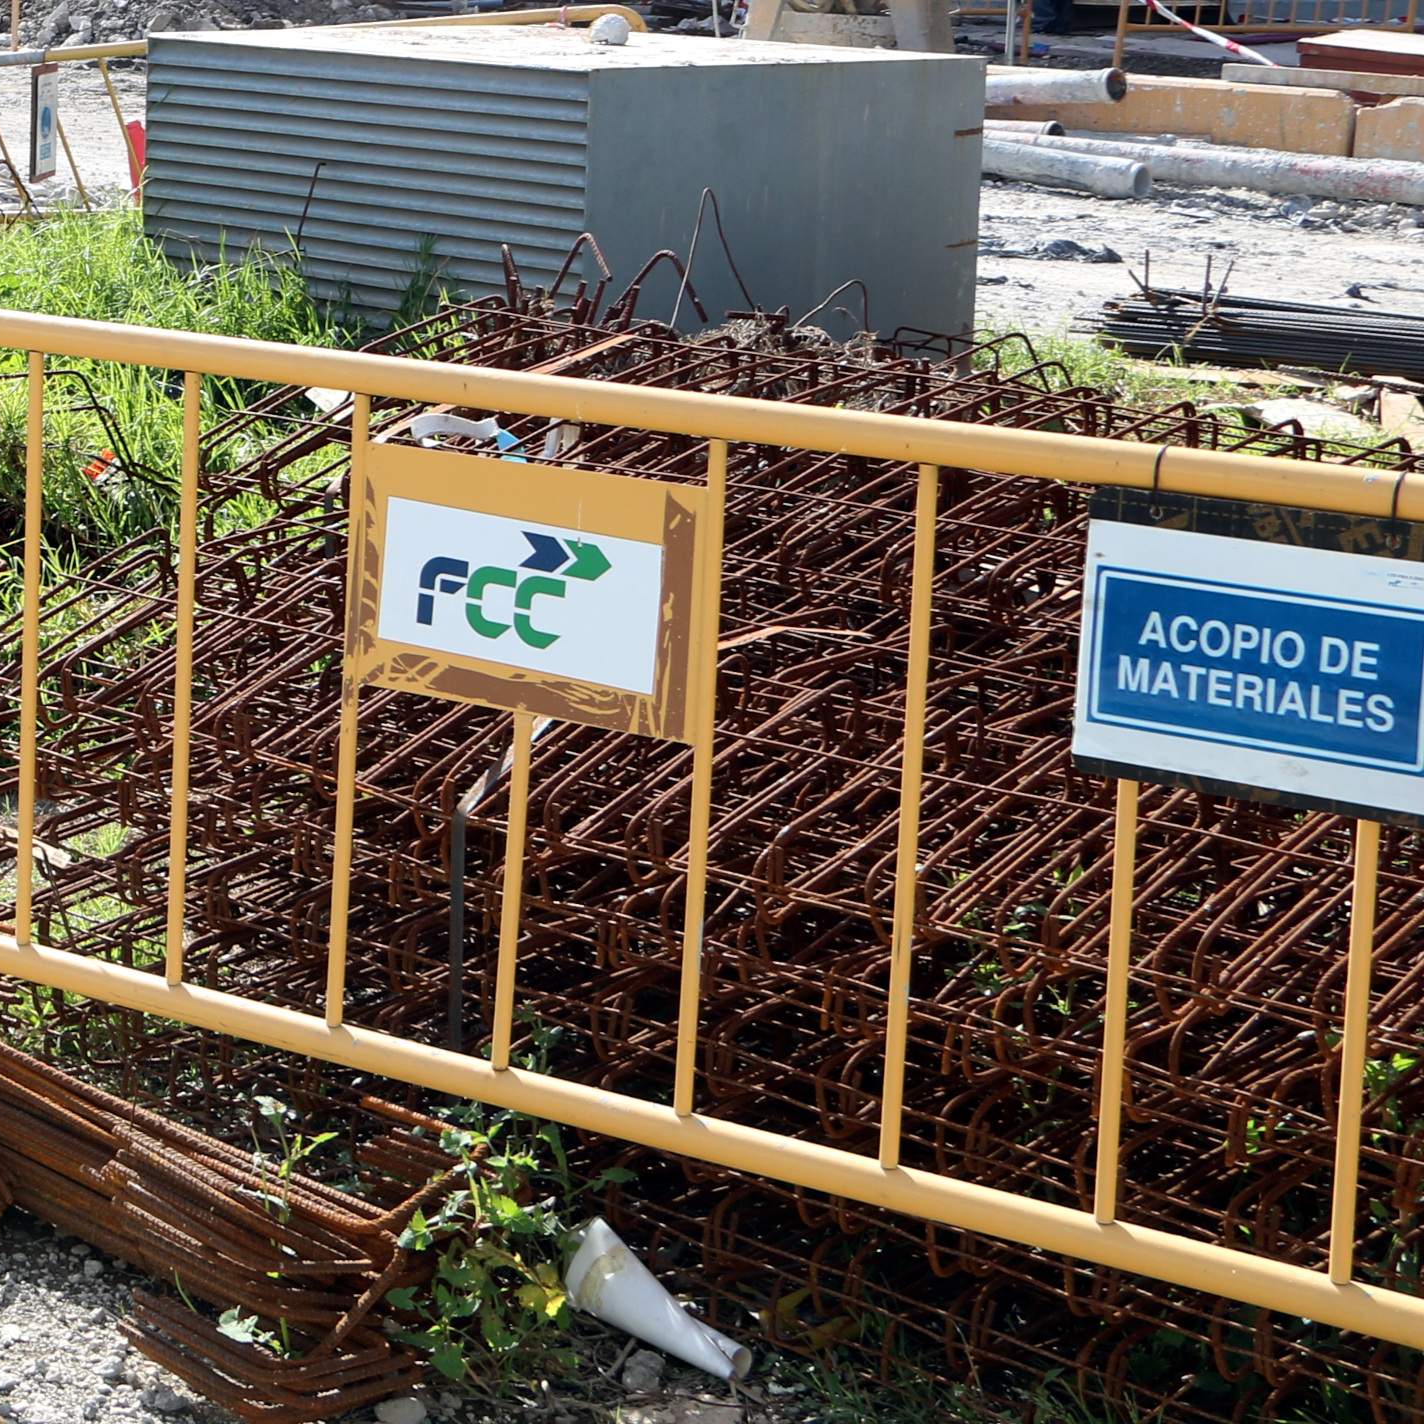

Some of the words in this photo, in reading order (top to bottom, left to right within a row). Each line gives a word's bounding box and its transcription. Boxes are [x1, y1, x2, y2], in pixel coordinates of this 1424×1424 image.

[416, 556, 566, 650] FCC
[1138, 611, 1305, 669] ACOPIO
[1319, 636, 1381, 680] DE
[1117, 655, 1395, 733] MATERIALES
